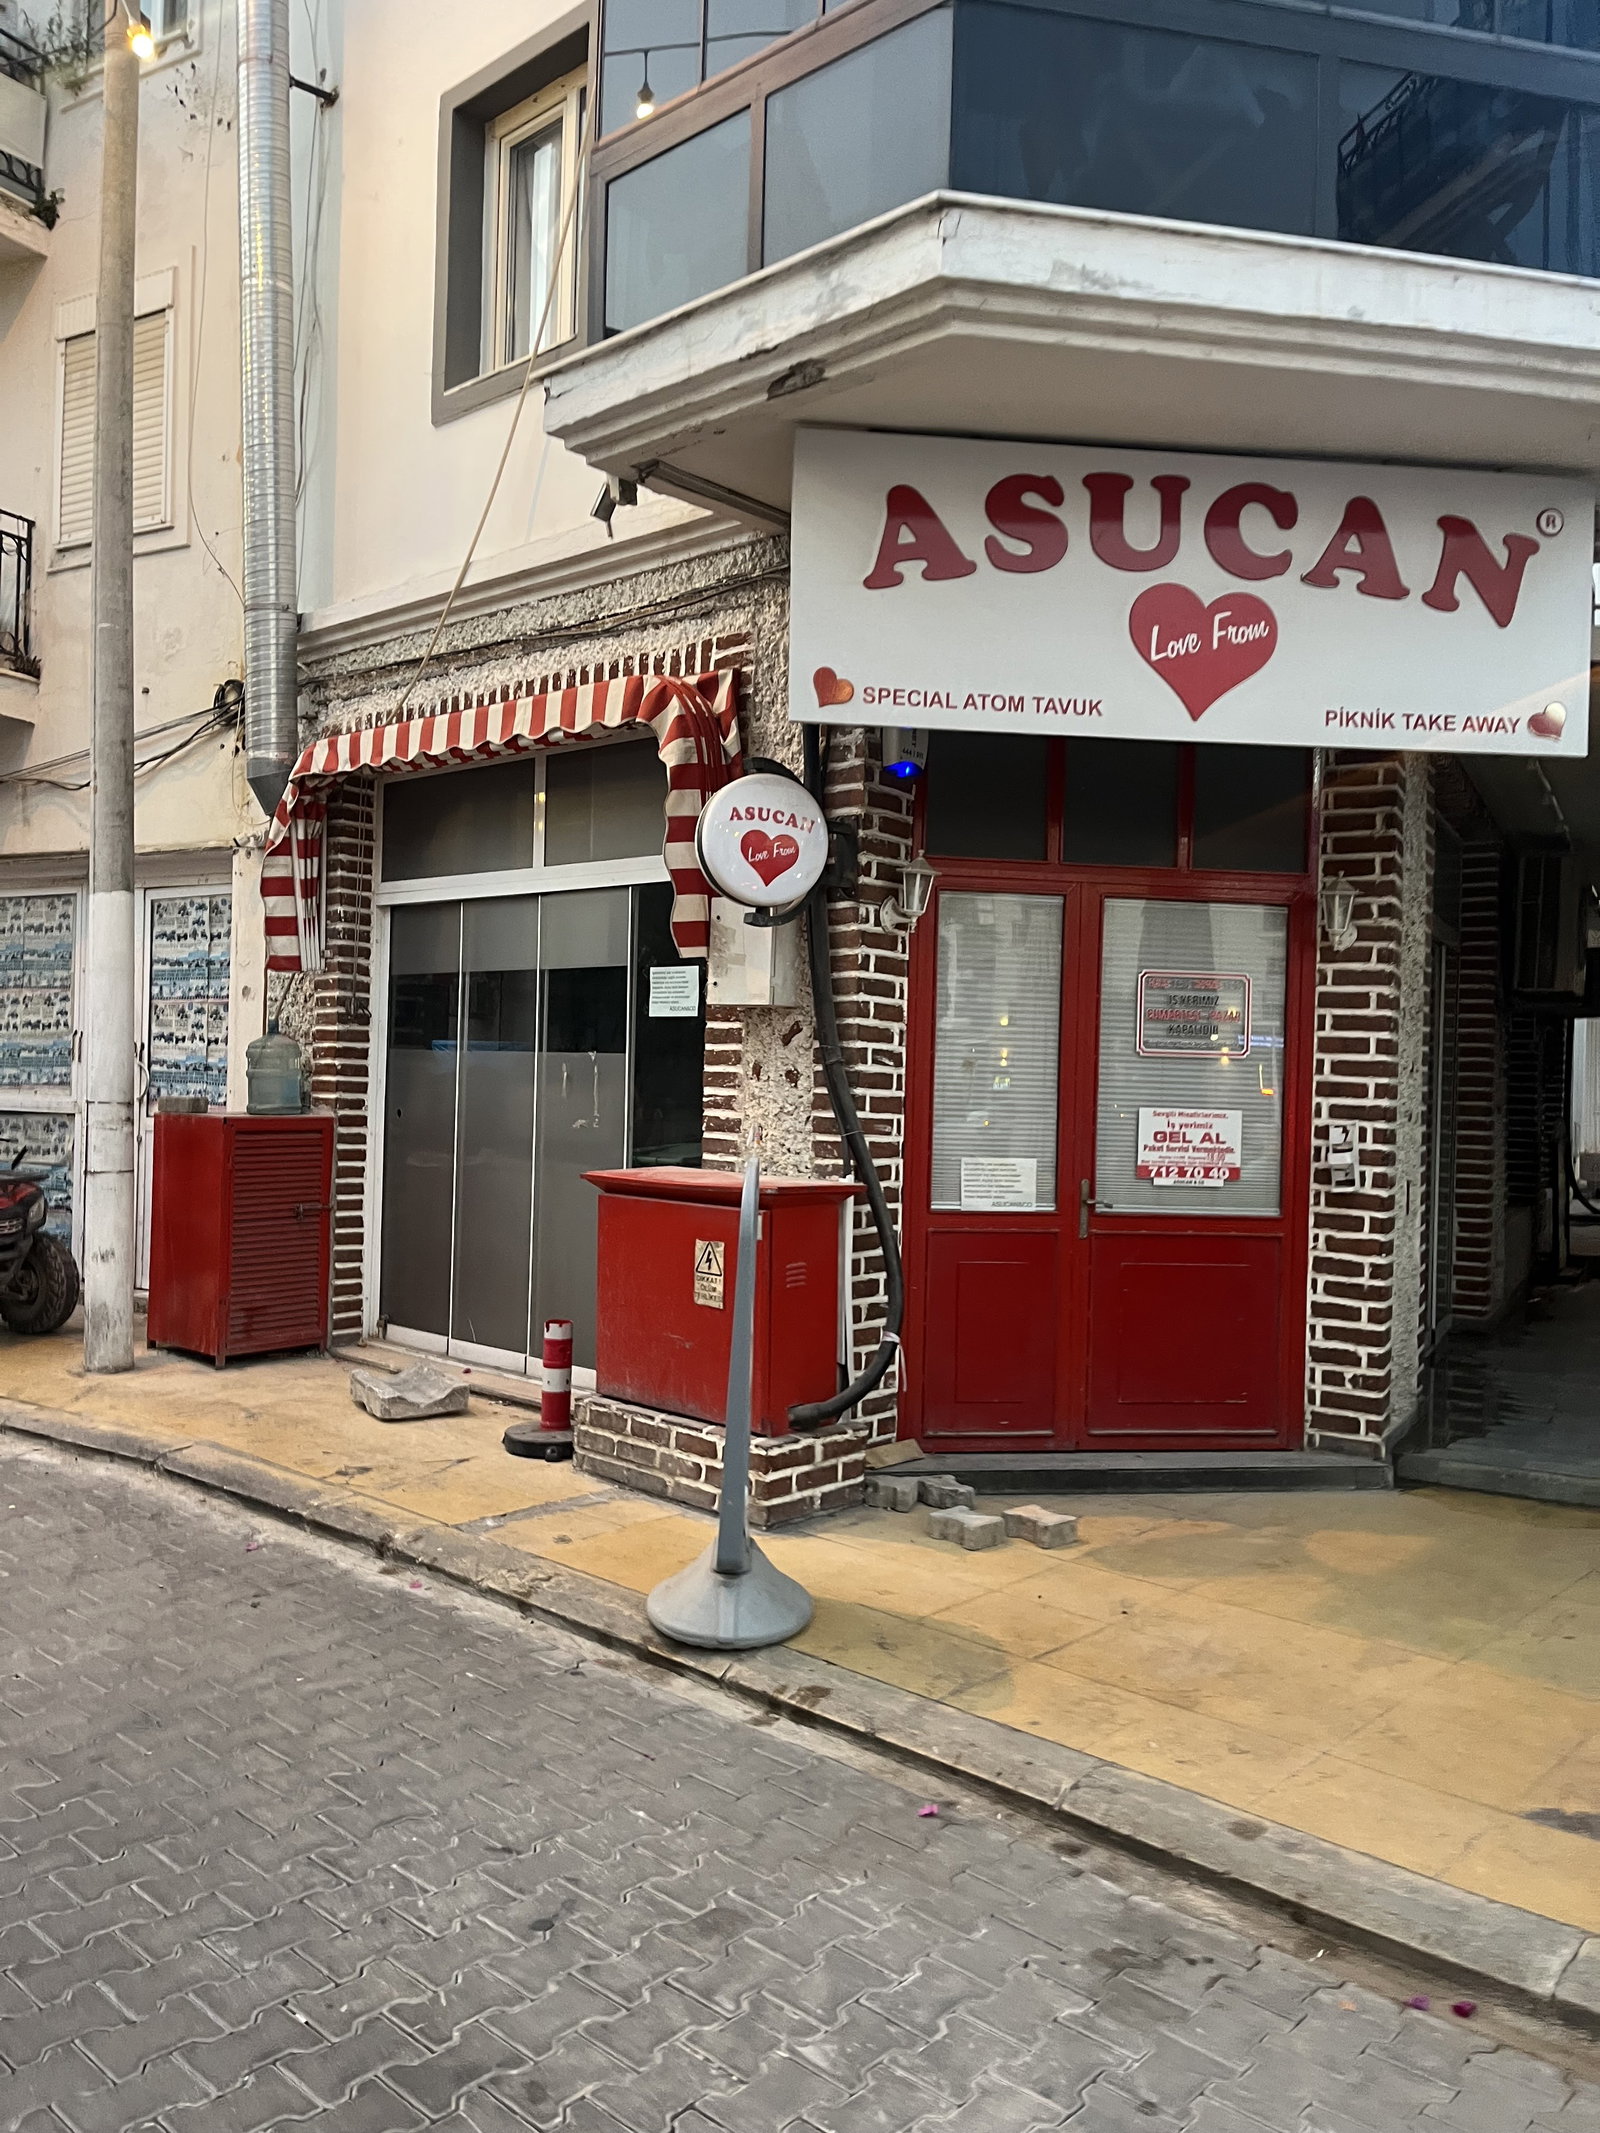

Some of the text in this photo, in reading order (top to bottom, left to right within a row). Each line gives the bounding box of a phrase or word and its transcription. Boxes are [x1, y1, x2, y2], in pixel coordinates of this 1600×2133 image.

[863, 472, 1541, 629] ASUCAN
[1150, 610, 1270, 662] Love From
[863, 686, 1104, 717] SPECIAL ATOM TAVUK
[1402, 713, 1457, 732] TAKE
[1461, 715, 1521, 734] AWAY
[729, 806, 815, 834] ASUCAN
[748, 841, 797, 862] Love From
[1153, 1131, 1227, 1145] GEL AL
[1149, 1166, 1230, 1180] 712 70 40
